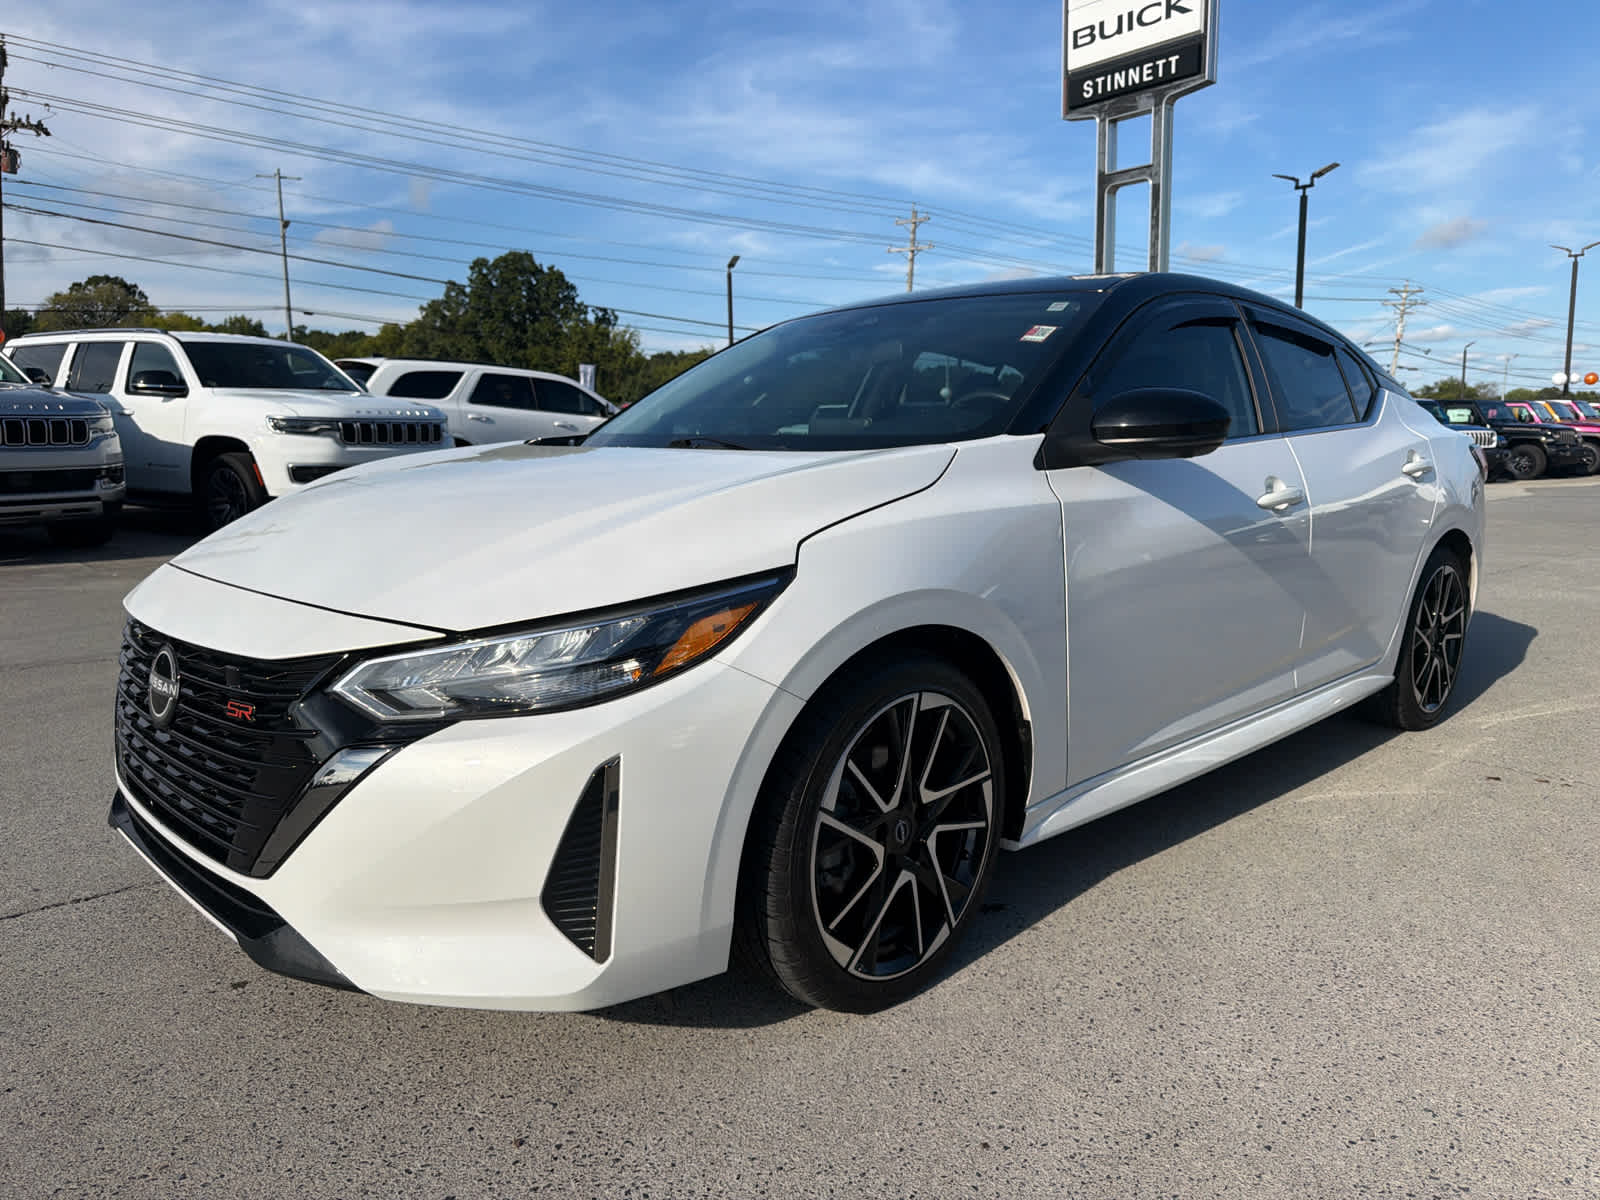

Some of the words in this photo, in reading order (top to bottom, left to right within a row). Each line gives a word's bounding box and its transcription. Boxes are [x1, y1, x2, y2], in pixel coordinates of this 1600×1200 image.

[1072, 0, 1193, 50] BUICK
[1082, 55, 1180, 98] STINNETT
[151, 676, 177, 696] SSAN
[226, 701, 254, 721] SR
